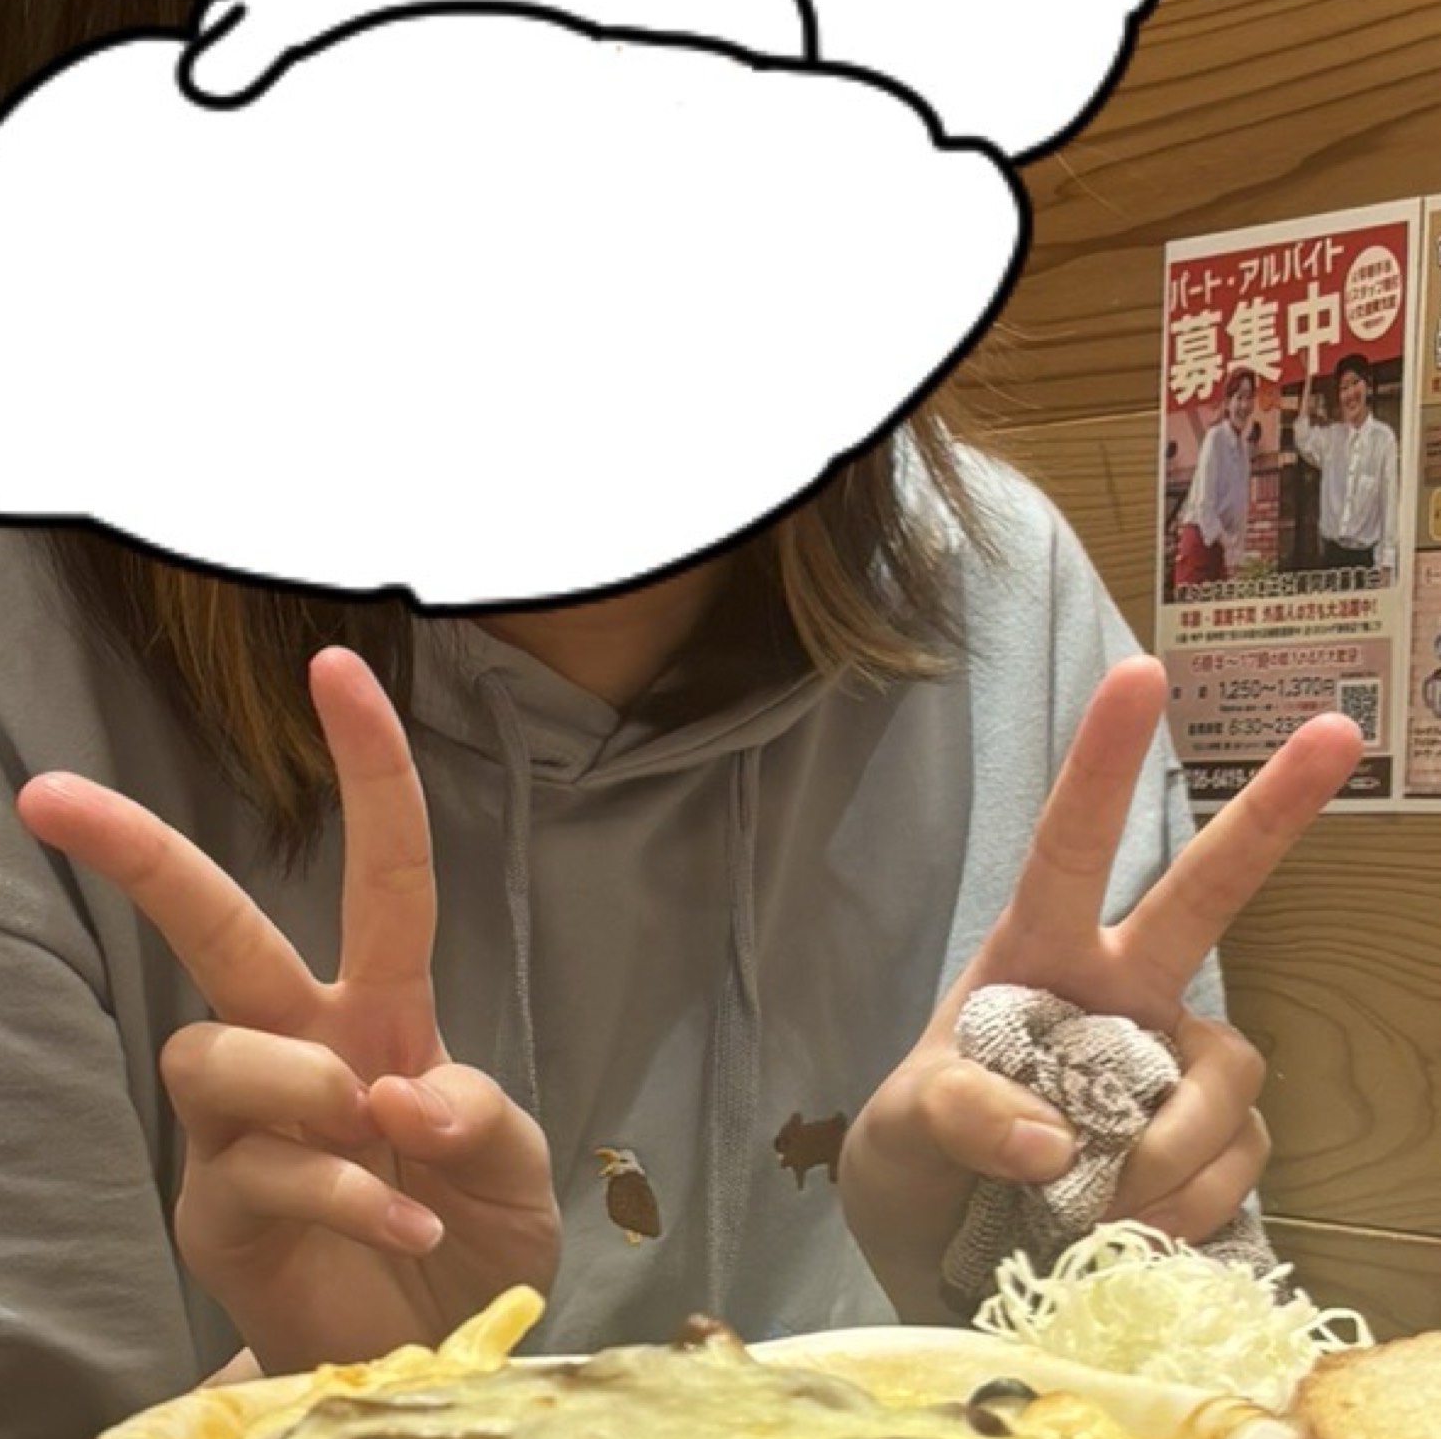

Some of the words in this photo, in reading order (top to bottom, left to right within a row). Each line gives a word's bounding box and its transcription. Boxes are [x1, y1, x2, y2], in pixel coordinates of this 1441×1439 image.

[1170, 237, 1345, 312] パート・アルバイト
[1170, 281, 1342, 405] 募集中
